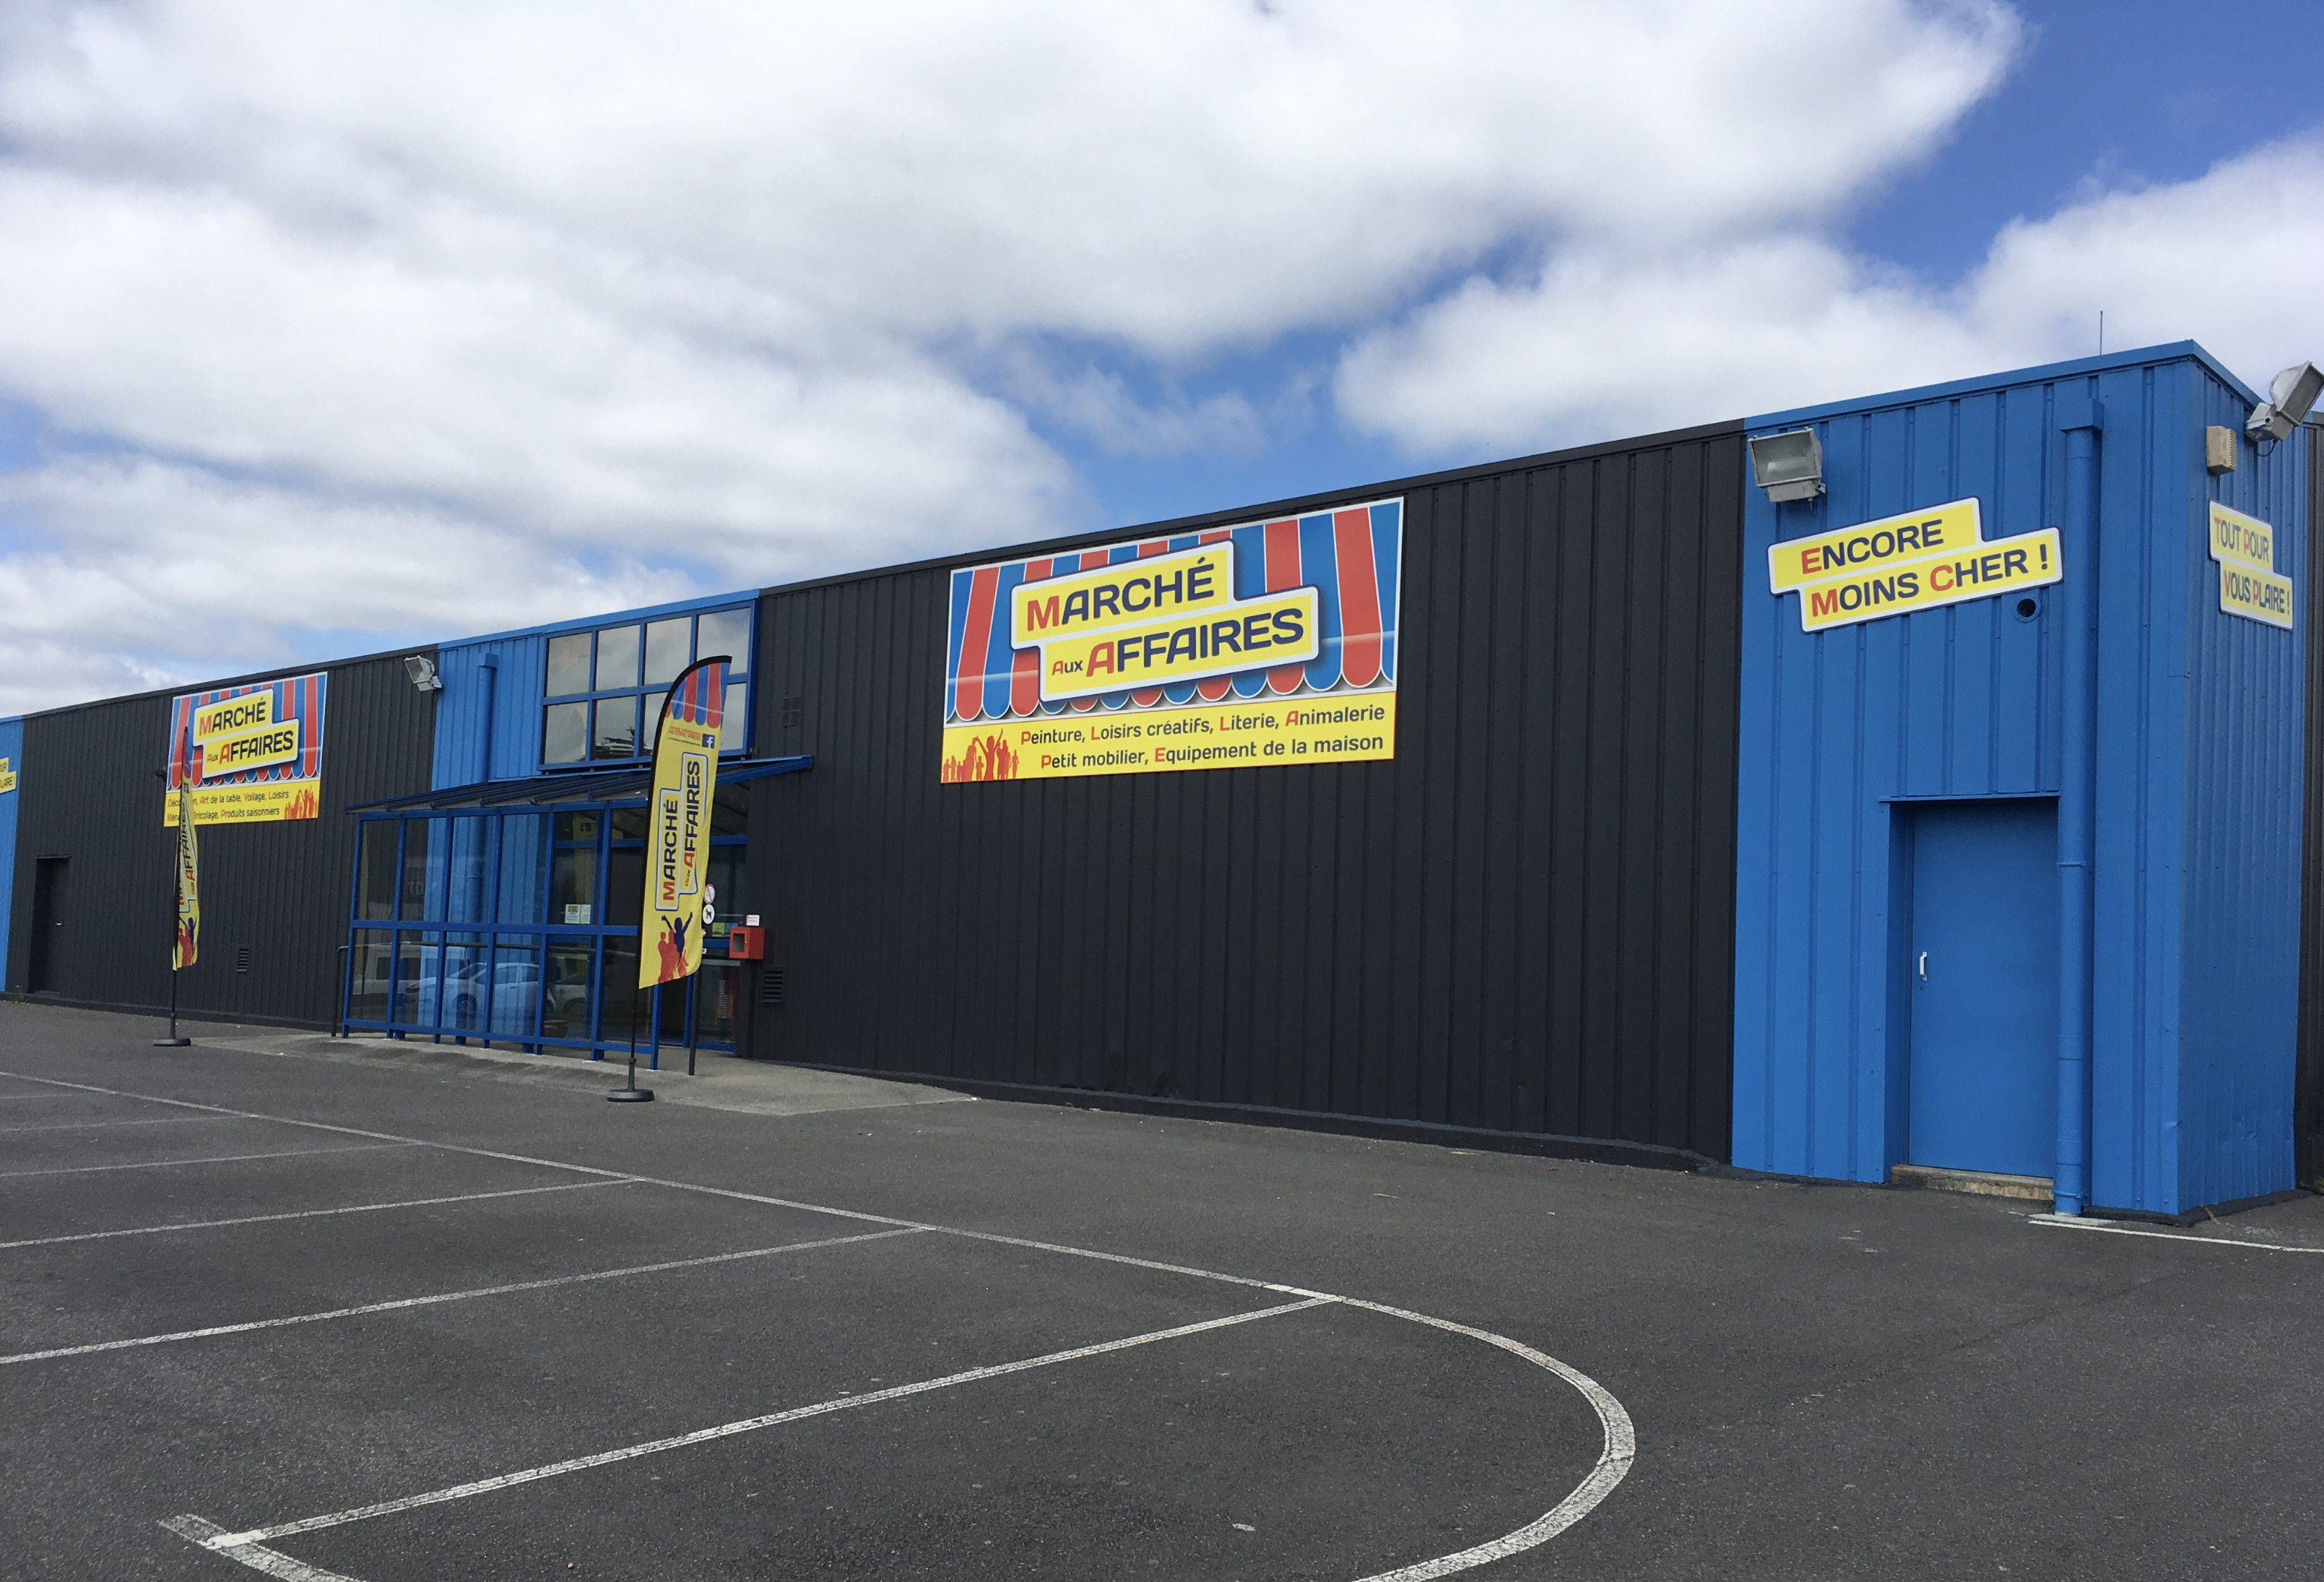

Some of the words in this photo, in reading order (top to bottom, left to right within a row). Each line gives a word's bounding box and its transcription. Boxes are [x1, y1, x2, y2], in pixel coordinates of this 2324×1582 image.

[1801, 519, 1944, 575] ENCORE
[2214, 516, 2241, 553] TOUT
[2243, 528, 2270, 563] POUR
[1026, 556, 1215, 632] MARCHÉ
[1811, 572, 1920, 618] MOINS
[1929, 548, 2029, 592] CHER
[2223, 569, 2251, 603] VOUS
[2253, 579, 2285, 614] PLAIRE
[1085, 608, 1304, 678] AFFAIRES
[199, 696, 266, 736] MARCHÉ
[1020, 728, 1085, 745] Peinture,
[1091, 724, 1142, 741] Loisirs
[1147, 717, 1213, 736] créatifs,
[1219, 713, 1280, 731] Literie,
[1285, 704, 1384, 727] Animalerie
[219, 730, 294, 764] AFFAIRES
[1041, 753, 1077, 769] Petit
[1082, 749, 1149, 767] mobilier,
[1155, 741, 1257, 764] Equipement
[1263, 740, 1285, 756] de
[1291, 739, 1307, 754] la
[1314, 735, 1384, 753] maison
[199, 795, 209, 805] Art
[210, 795, 218, 804] de
[219, 794, 225, 803] la
[226, 793, 242, 803] table,
[268, 790, 289, 800] Loisirs
[220, 808, 246, 818] Produits
[246, 807, 280, 817] saisonniers
[683, 761, 701, 868] AFFAIRES
[663, 799, 678, 901] MARCHÉ
